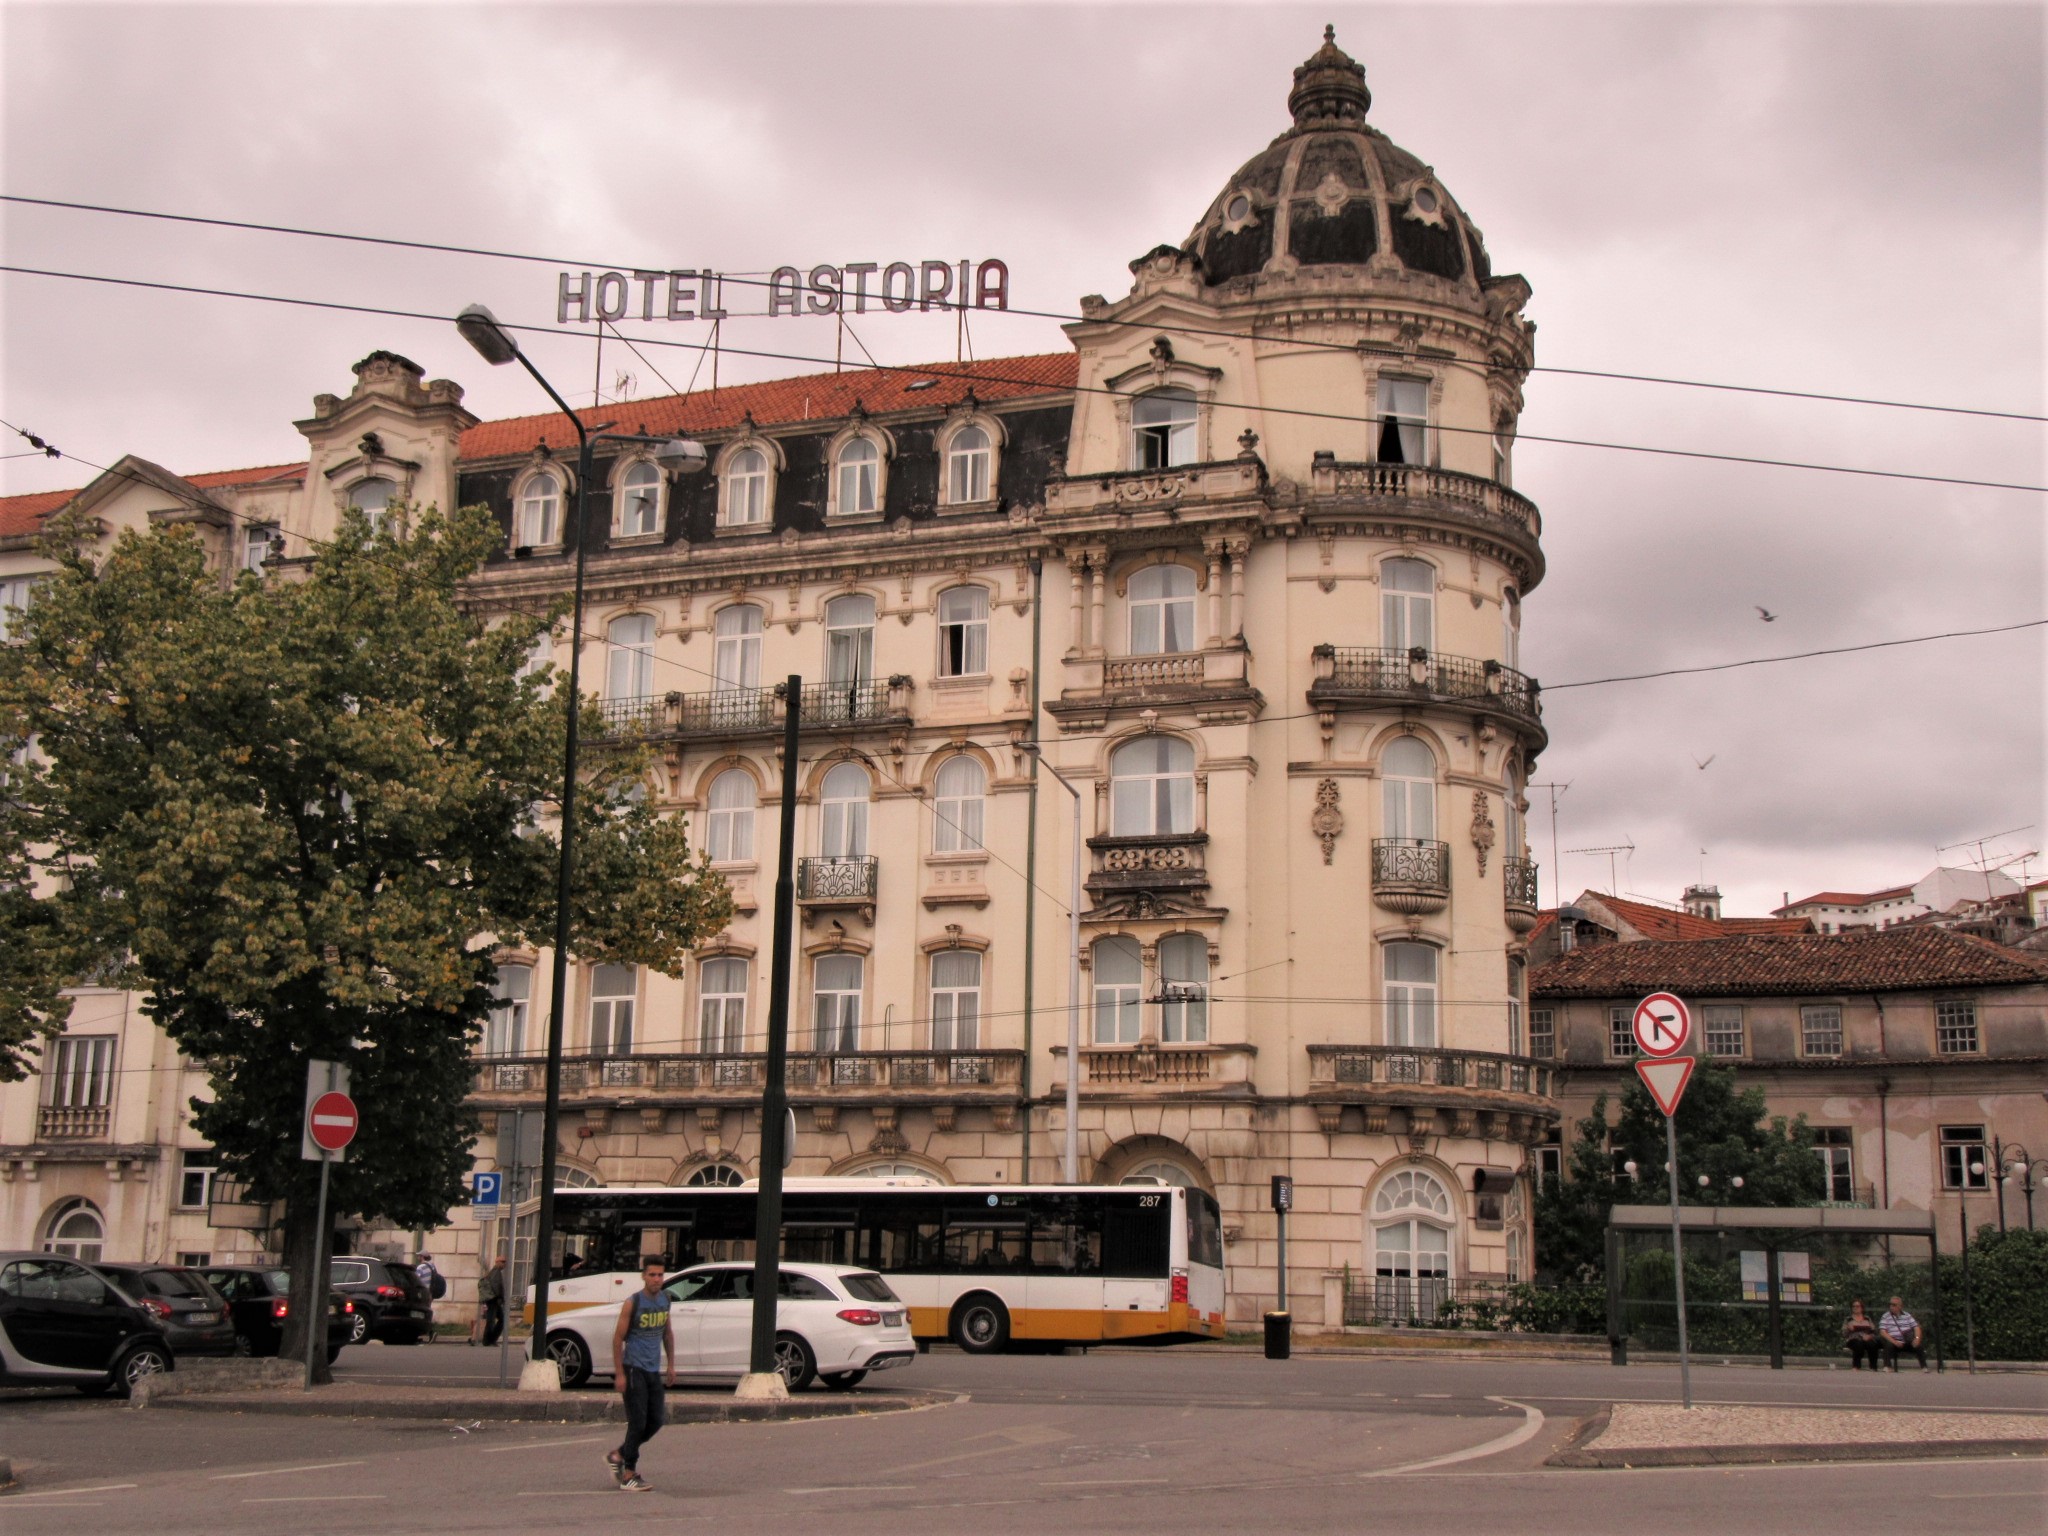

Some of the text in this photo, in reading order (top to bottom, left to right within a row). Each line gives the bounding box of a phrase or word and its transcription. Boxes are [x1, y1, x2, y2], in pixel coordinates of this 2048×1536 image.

[558, 258, 1009, 323] HOTEL ASTORIA
[477, 1176, 495, 1202] P
[1140, 1195, 1161, 1207] 287
